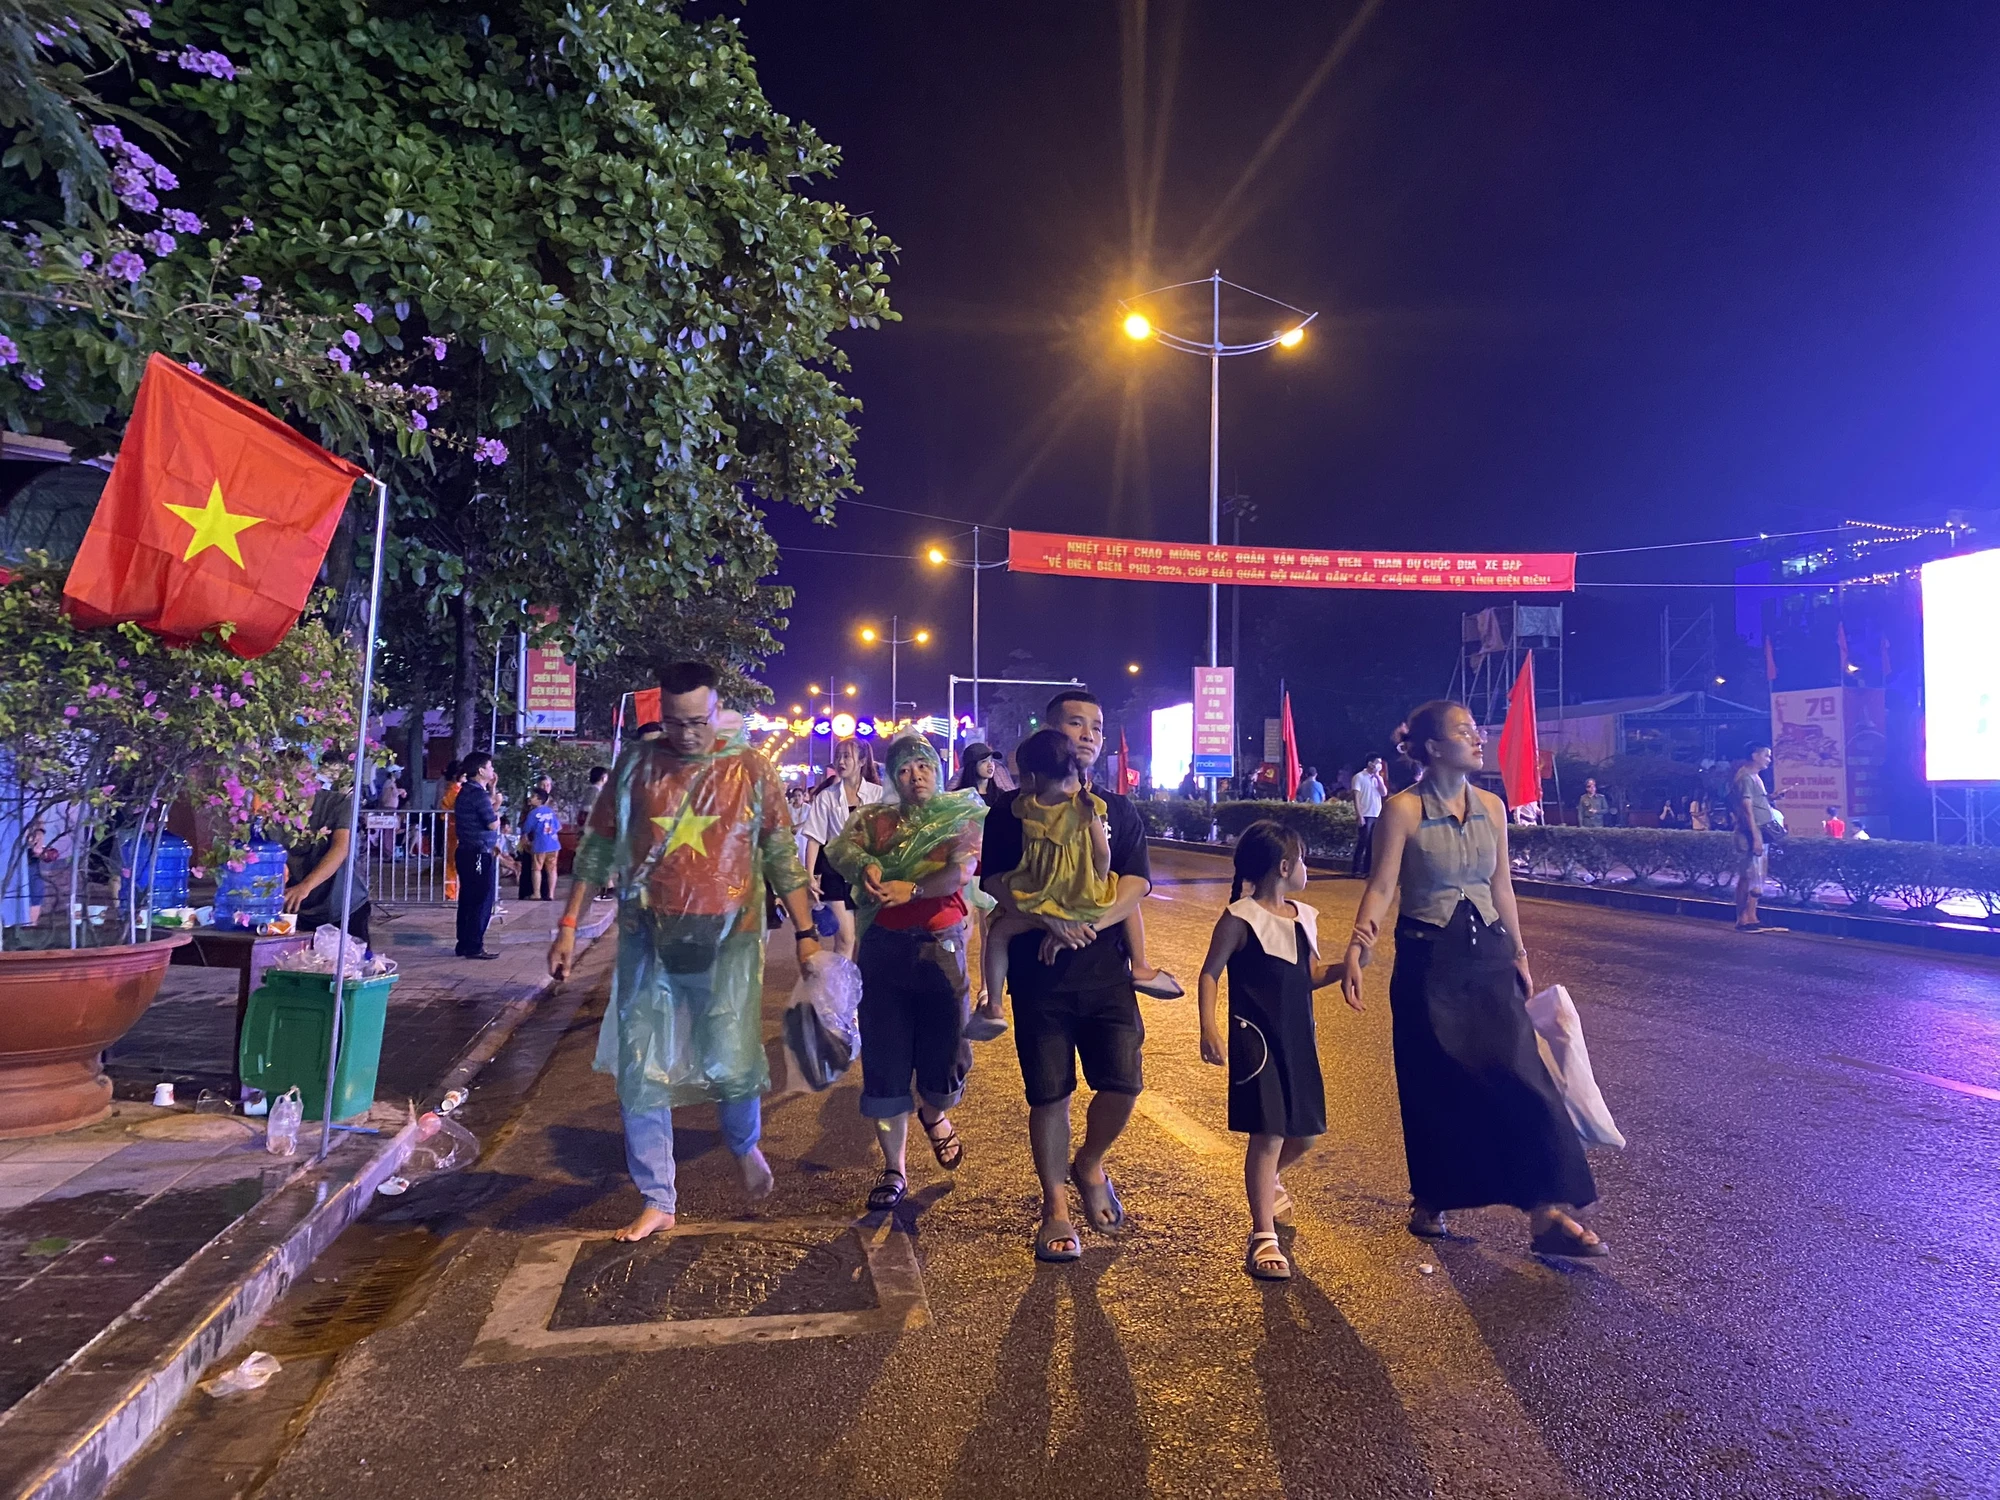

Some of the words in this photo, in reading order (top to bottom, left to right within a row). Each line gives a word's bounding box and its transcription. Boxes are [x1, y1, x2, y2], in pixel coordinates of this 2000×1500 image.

[1206, 549, 1229, 562] CÁC
[1485, 559, 1499, 570] XE
[1804, 696, 1836, 717] 70
